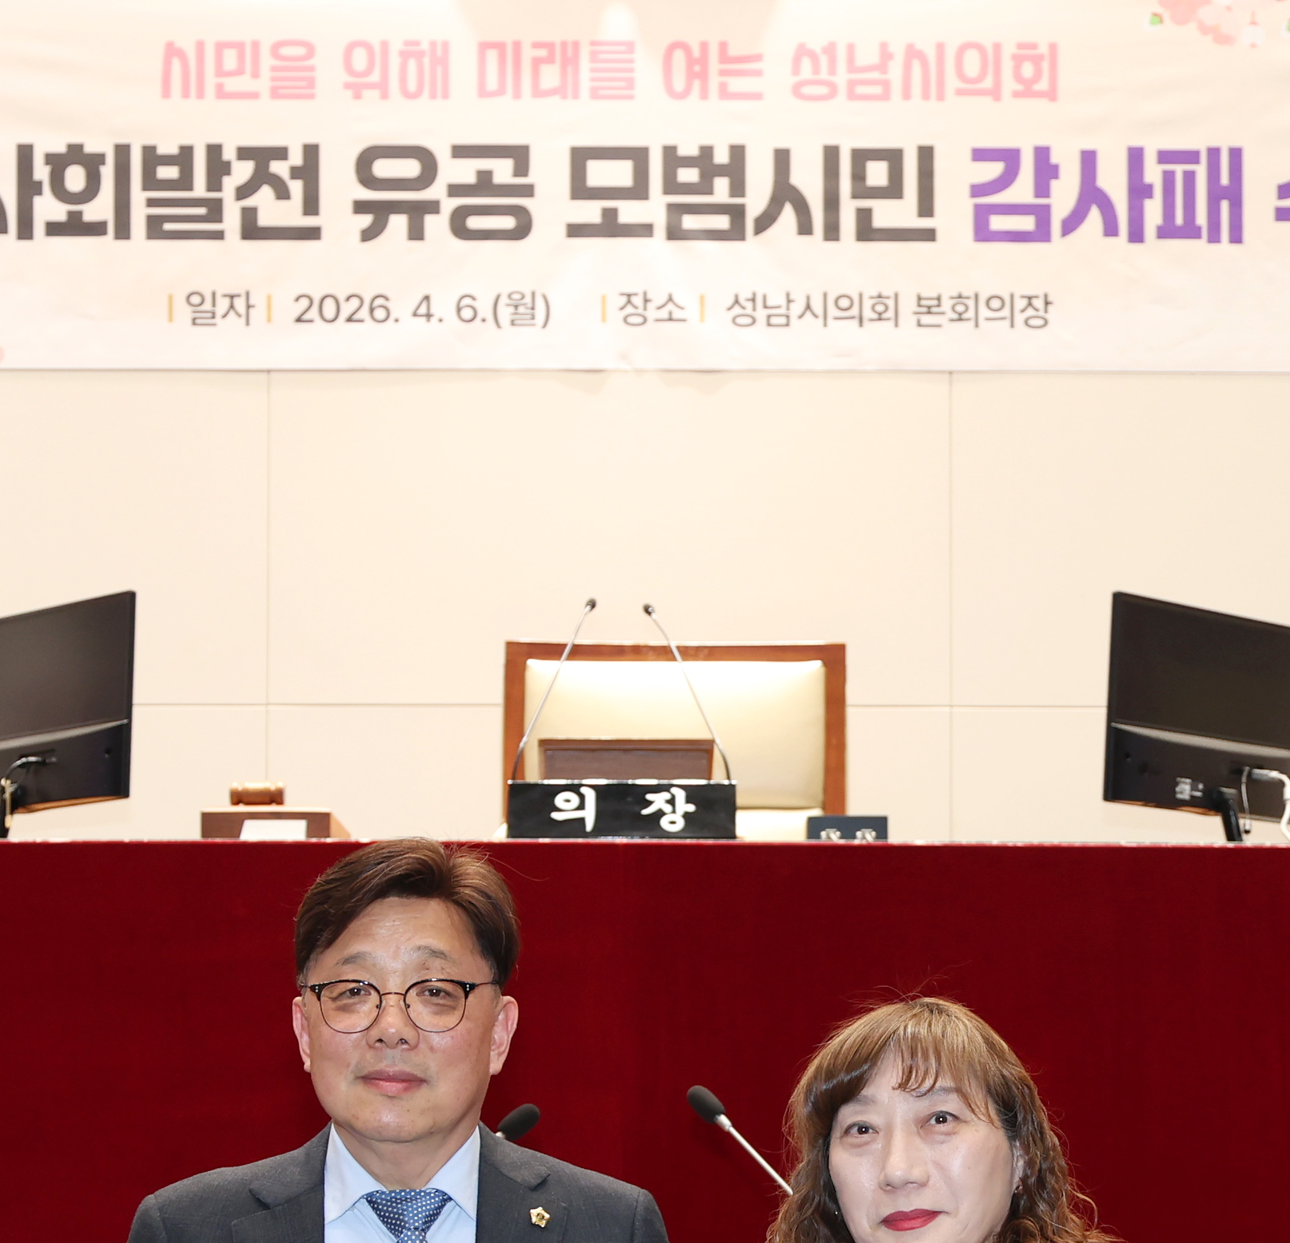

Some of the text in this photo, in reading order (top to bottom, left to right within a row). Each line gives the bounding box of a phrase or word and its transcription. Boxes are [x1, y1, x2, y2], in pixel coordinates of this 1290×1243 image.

[161, 39, 1058, 102] 시민을 위해 미래를 여는 성남시의회
[353, 145, 534, 242] 유공
[566, 145, 936, 242] 모범시민
[970, 146, 1243, 244] 감사패
[186, 292, 253, 326] 일자
[295, 294, 398, 323] 2026.
[413, 295, 442, 322] 4.
[619, 291, 686, 327] 장소
[727, 292, 899, 328] 성남시의회
[914, 292, 1053, 329] 본회의장
